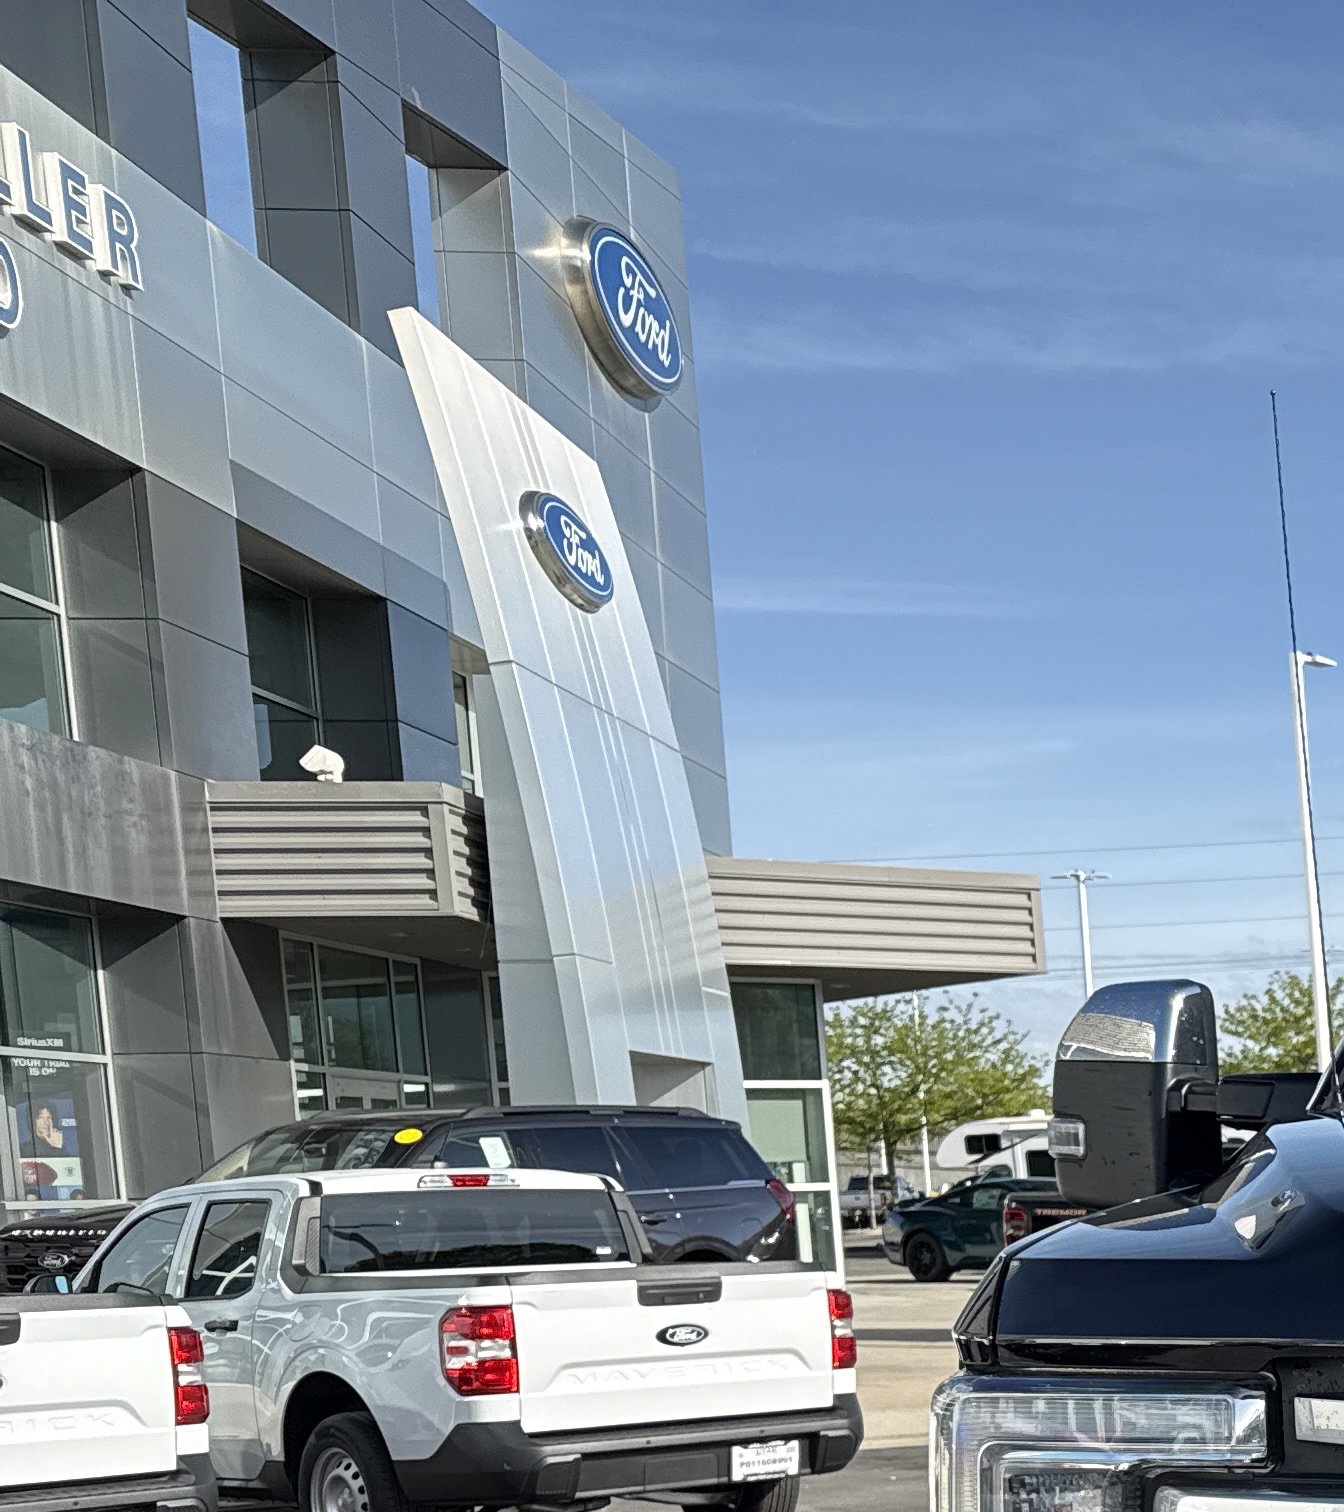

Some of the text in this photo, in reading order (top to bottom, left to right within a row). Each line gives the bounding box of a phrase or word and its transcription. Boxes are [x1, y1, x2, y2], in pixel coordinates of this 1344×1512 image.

[617, 255, 672, 368] Ford
[560, 514, 604, 586] Ford
[567, 1359, 788, 1385] MAVERICK
